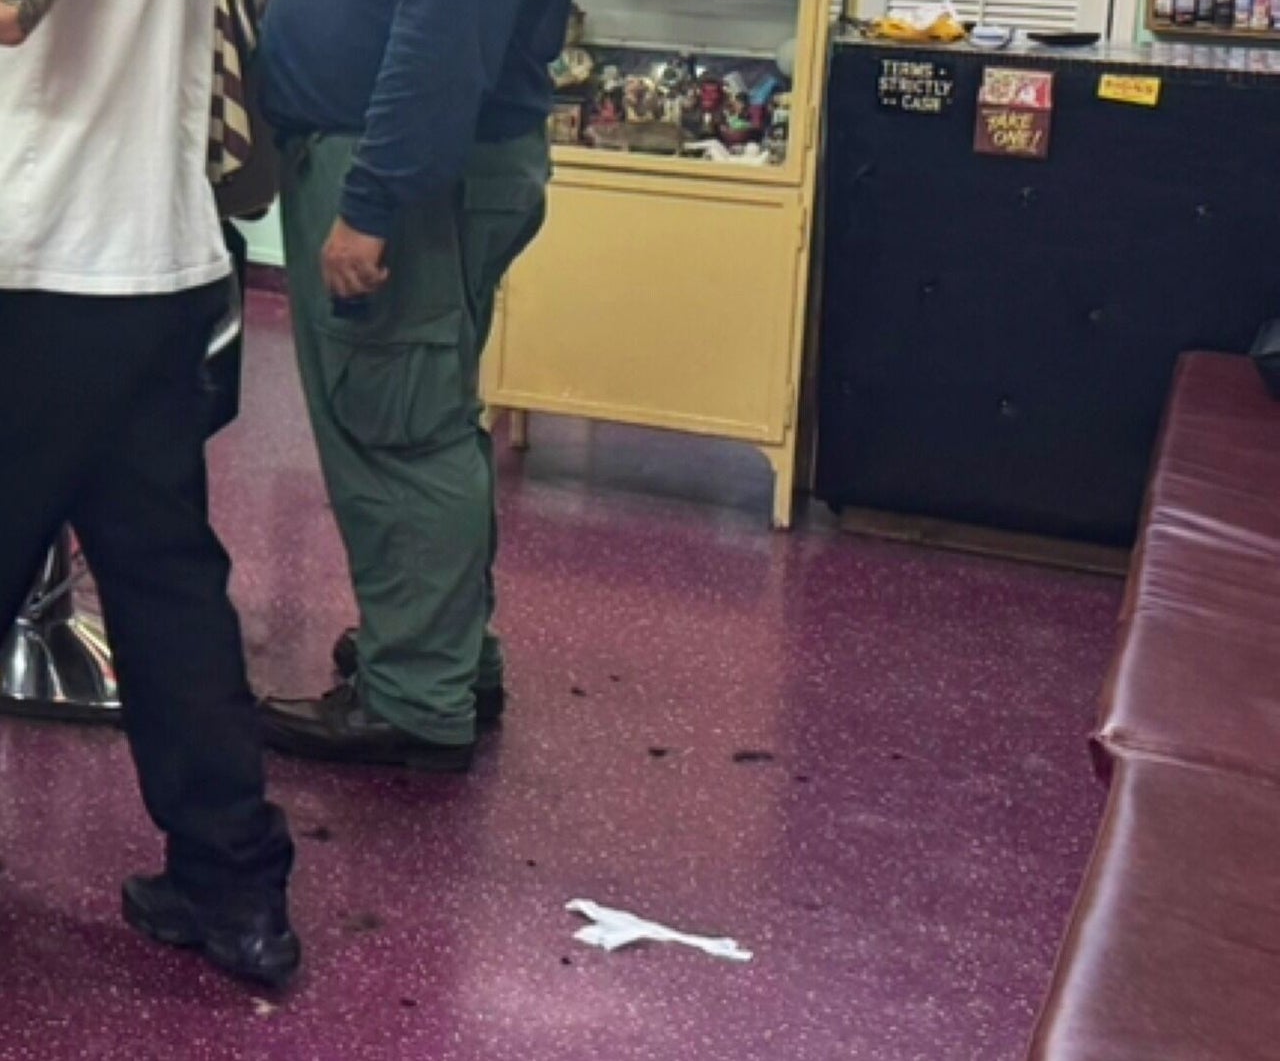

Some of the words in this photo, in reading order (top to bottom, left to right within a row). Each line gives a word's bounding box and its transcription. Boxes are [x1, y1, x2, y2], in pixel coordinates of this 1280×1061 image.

[880, 58, 934, 79] TERMS
[877, 76, 954, 98] STRICTLY
[900, 94, 942, 114] CASH
